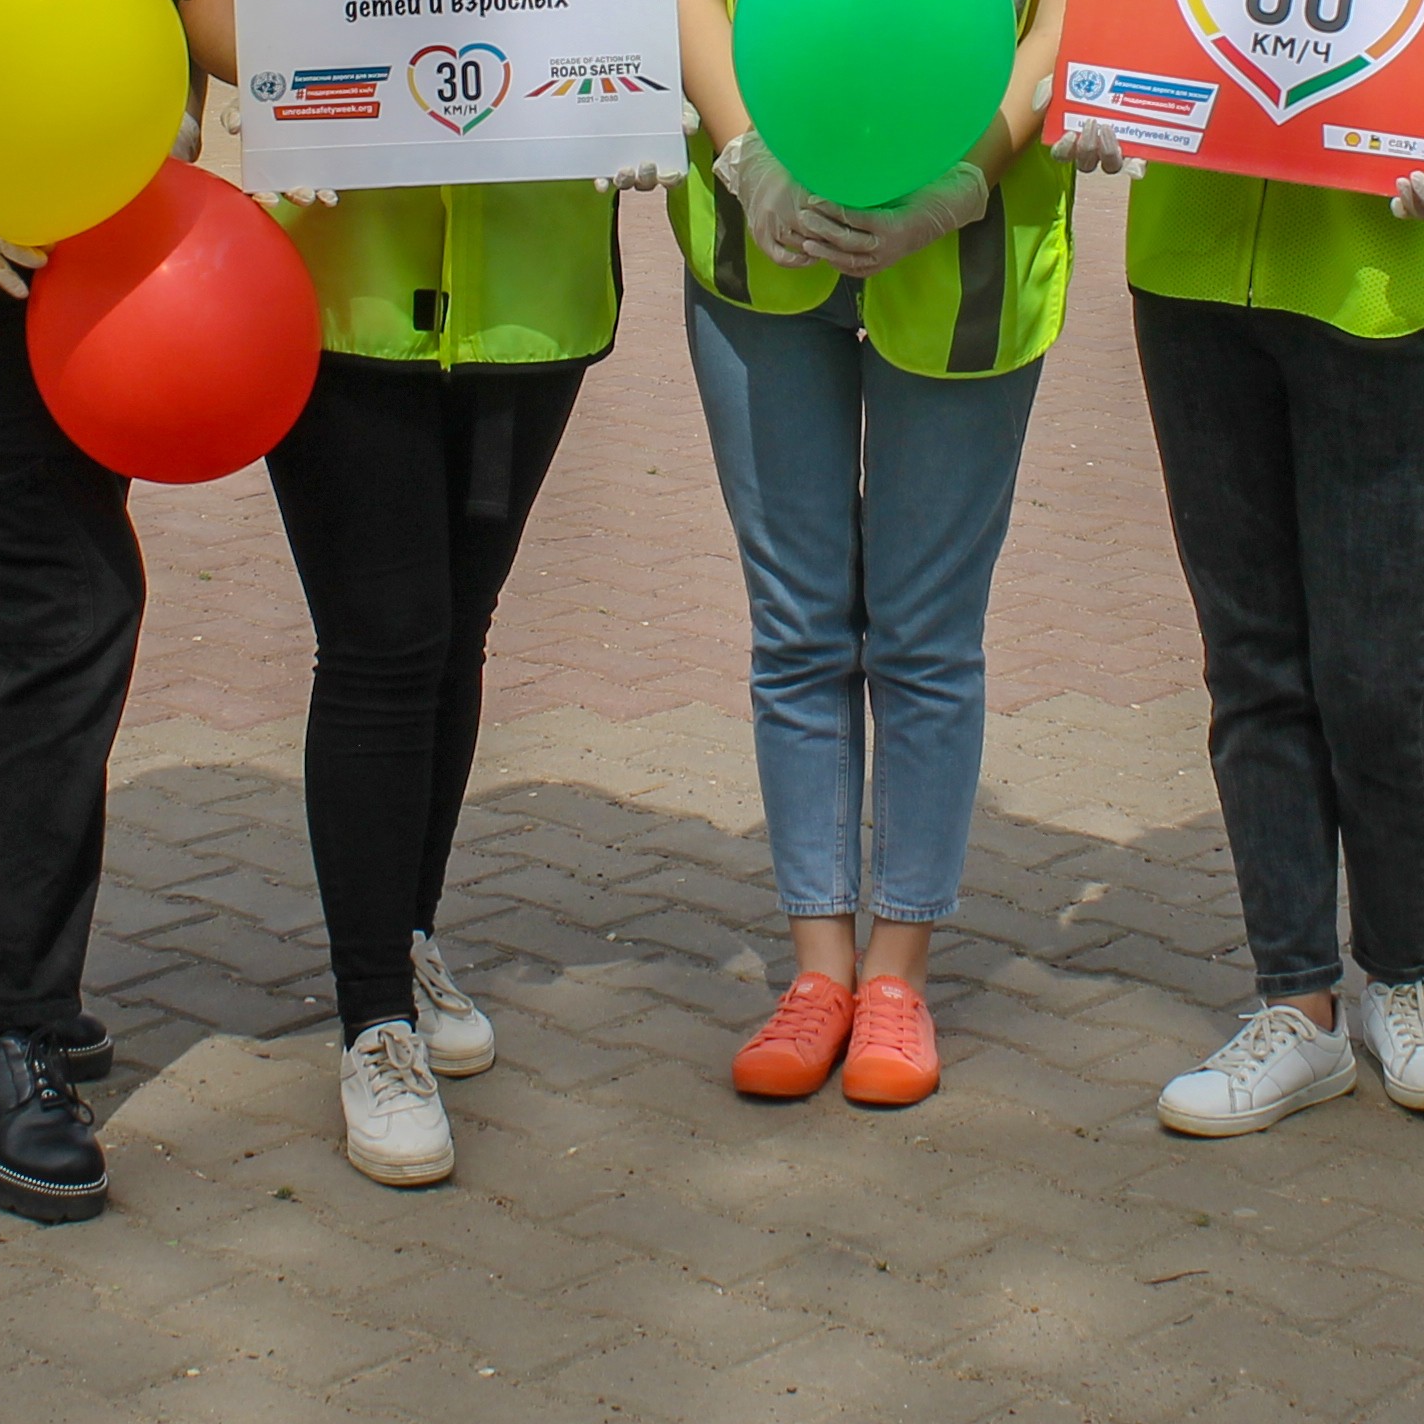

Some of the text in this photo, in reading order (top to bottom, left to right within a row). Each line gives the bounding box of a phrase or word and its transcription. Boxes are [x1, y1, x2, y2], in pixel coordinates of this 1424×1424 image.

[1250, 33, 1332, 63] КМ/Ч
[550, 57, 581, 65] DECADE
[595, 55, 624, 63] ACTION
[625, 54, 642, 62] FOR
[550, 62, 641, 78] ROAD SAFETY
[436, 60, 482, 103] 30
[282, 105, 373, 116] unroadsafetyweek.org
[443, 104, 478, 116] KM/H
[1078, 120, 1191, 145] usafetyweek.org
